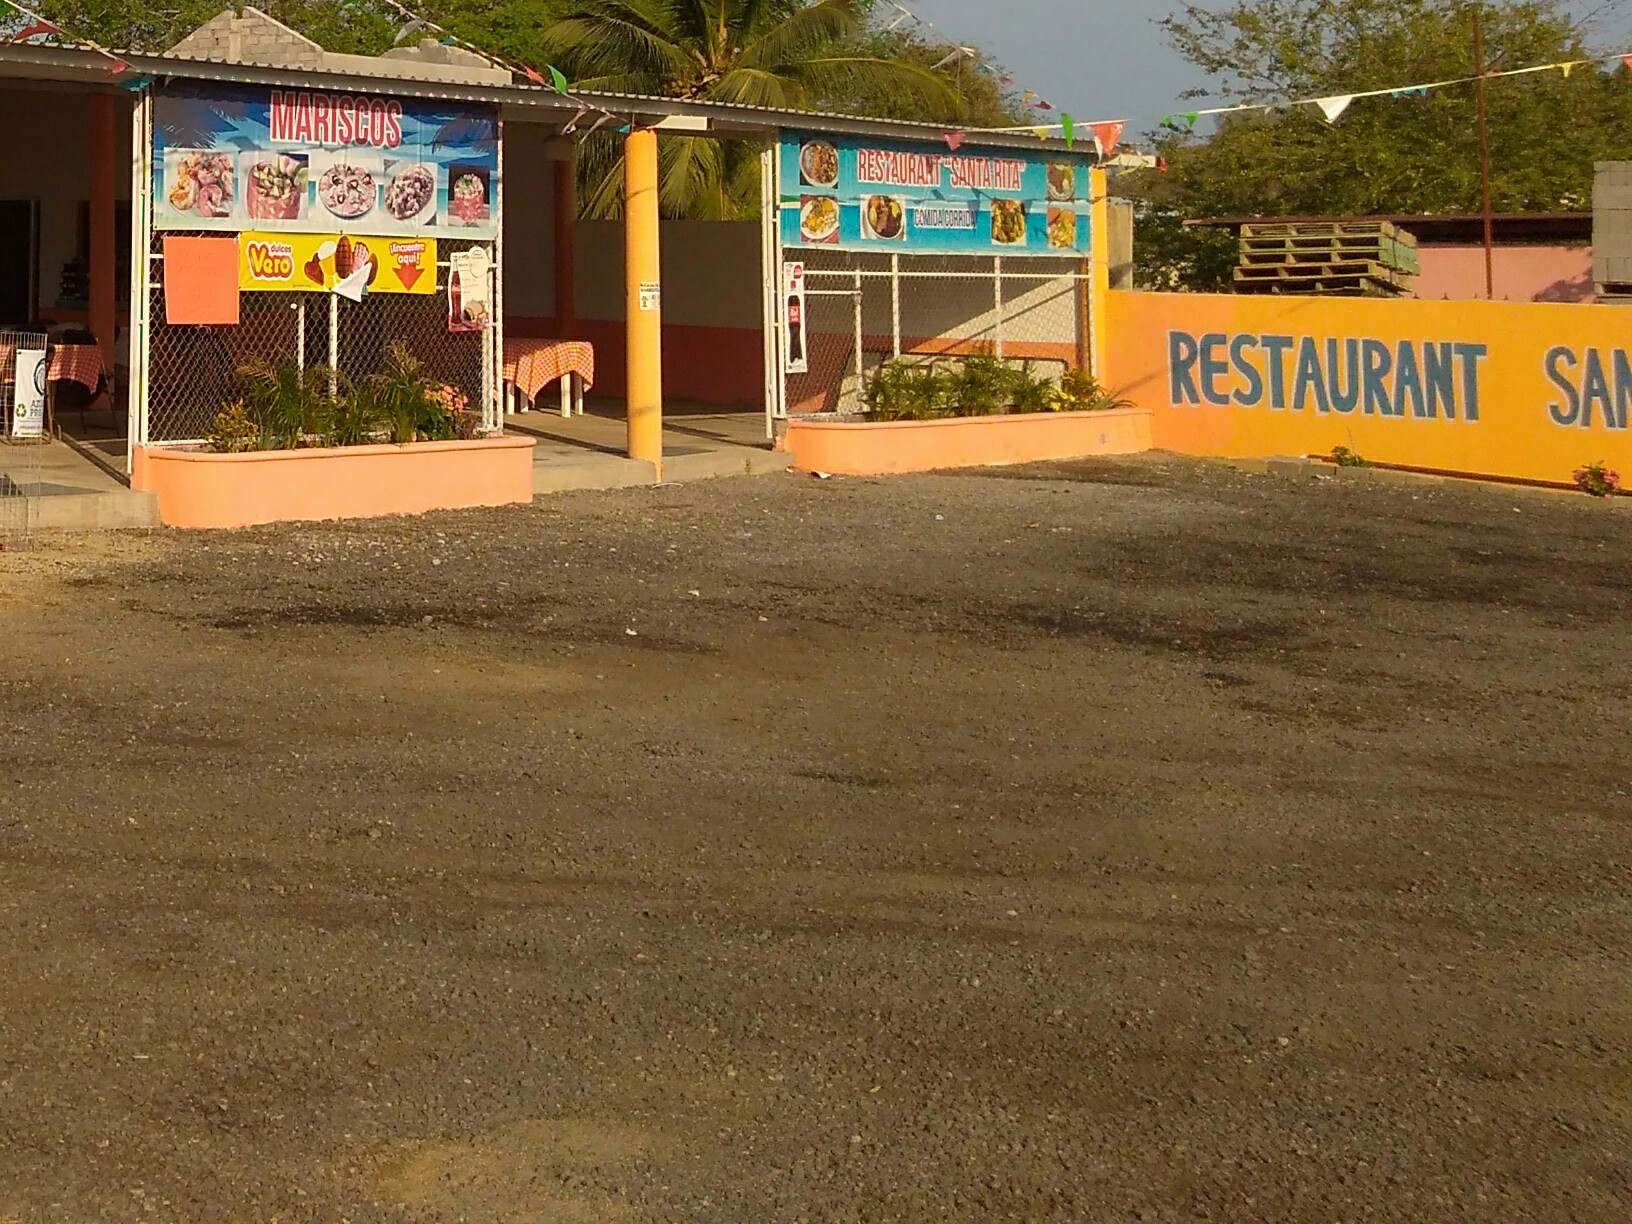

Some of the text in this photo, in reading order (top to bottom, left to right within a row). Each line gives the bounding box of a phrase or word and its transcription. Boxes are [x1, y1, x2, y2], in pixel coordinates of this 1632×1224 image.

[270, 90, 403, 148] MARISCOS
[857, 150, 941, 186] RESTAURANT
[914, 208, 976, 227] COMIDA CORRIDA
[250, 246, 291, 277] Vero
[270, 243, 292, 253] dulces
[1169, 330, 1487, 422] RESTAURANT
